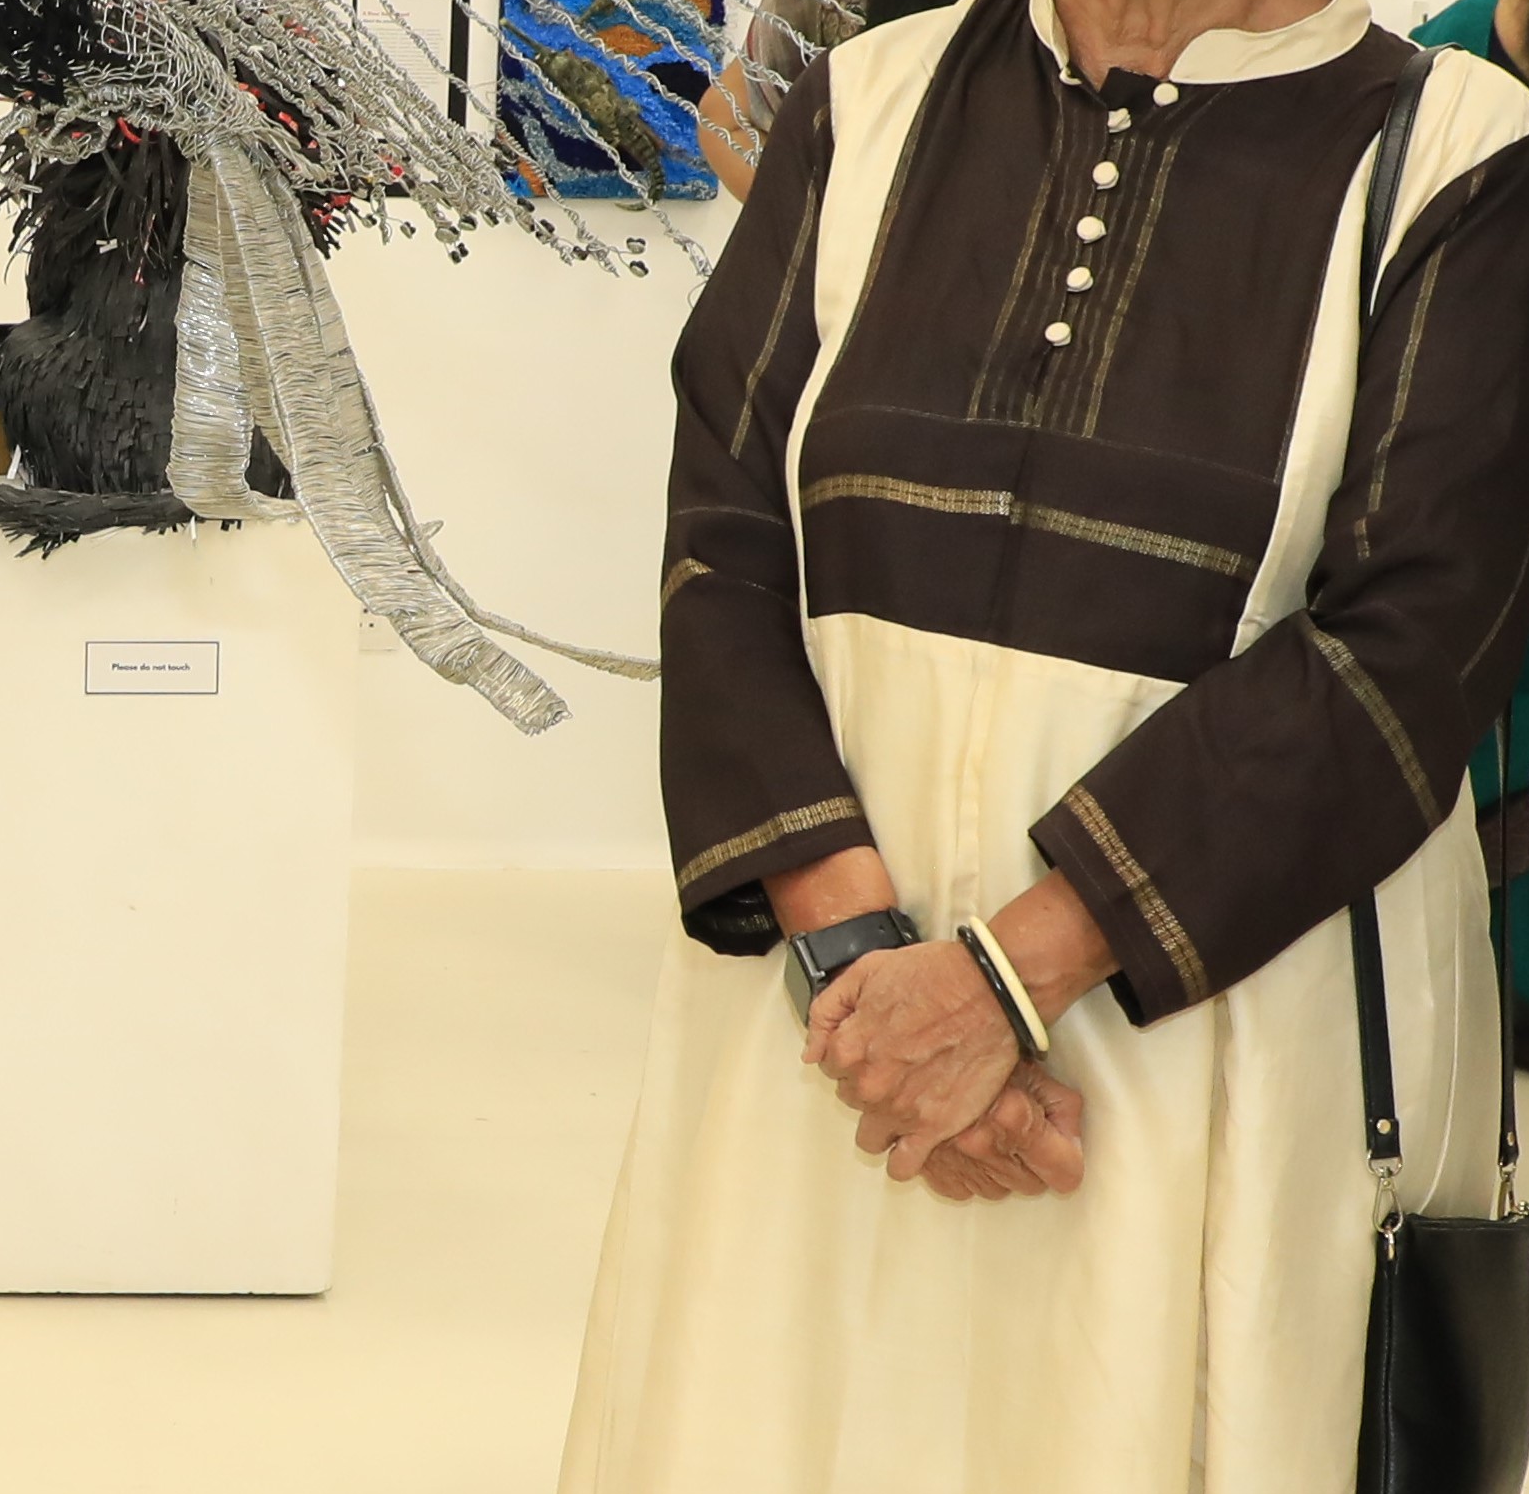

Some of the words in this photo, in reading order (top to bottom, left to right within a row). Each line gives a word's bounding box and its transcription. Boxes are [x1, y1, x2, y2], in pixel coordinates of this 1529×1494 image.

[111, 663, 138, 671] Please
[139, 663, 150, 671] do
[168, 663, 191, 671] touch
